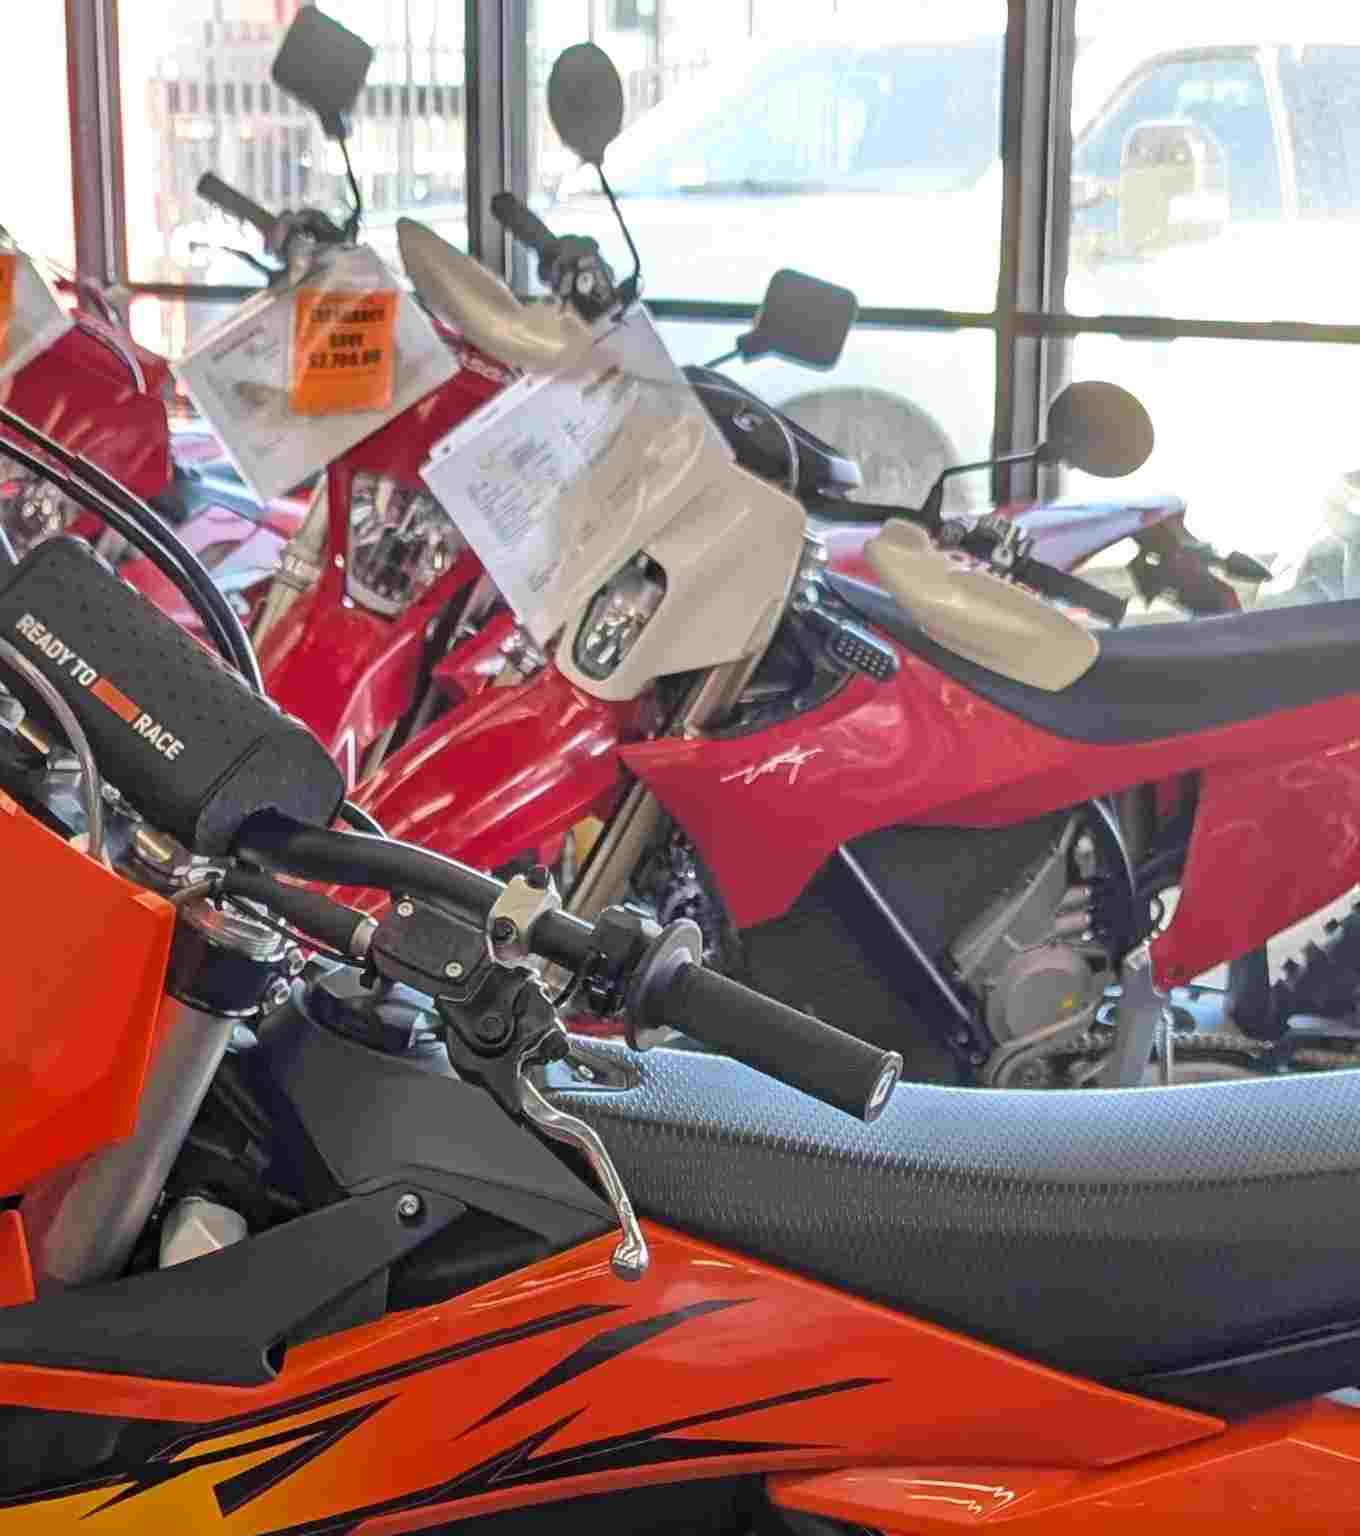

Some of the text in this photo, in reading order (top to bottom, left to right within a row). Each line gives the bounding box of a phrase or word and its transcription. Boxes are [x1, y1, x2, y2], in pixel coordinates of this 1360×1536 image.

[15, 612, 186, 762] READY TO RACE
